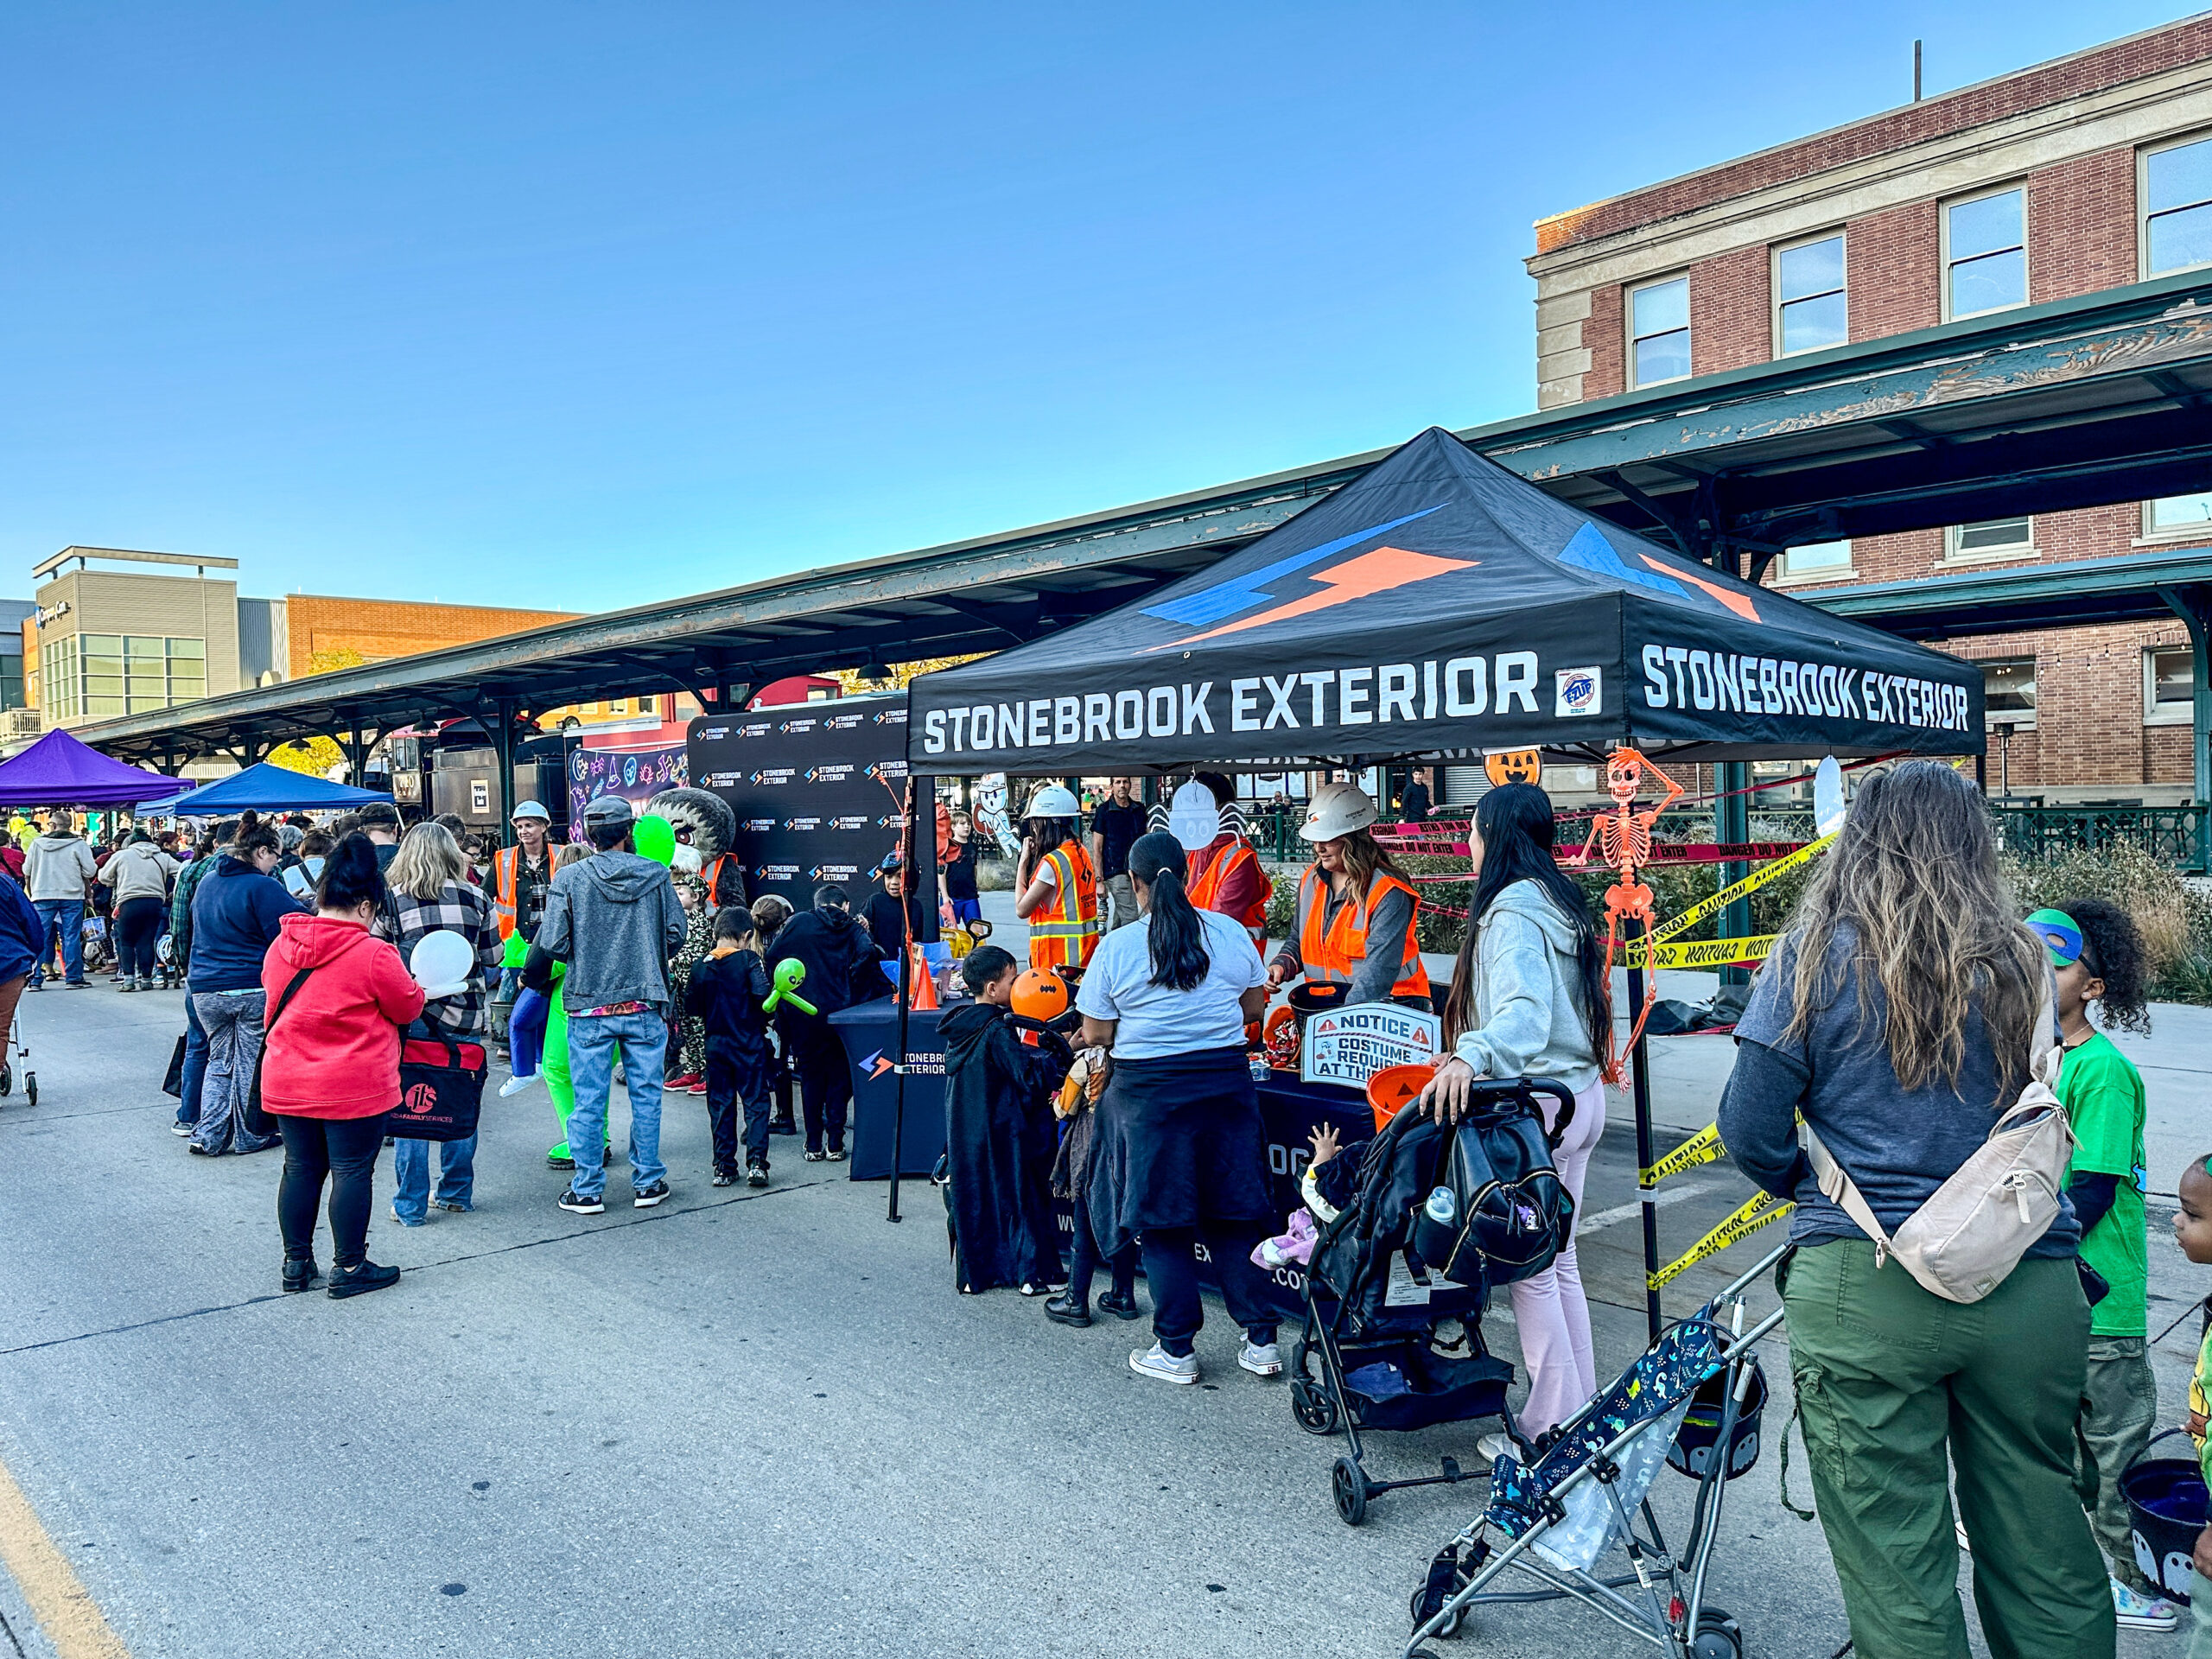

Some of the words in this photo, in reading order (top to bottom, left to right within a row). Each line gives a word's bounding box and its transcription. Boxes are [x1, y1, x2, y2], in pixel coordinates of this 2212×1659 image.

[1642, 644, 1859, 719] STONEBROOK
[1861, 671, 1968, 732] EXTERIOR
[924, 681, 1216, 754] STONEBROOK
[1230, 651, 1539, 732] EXTERIOR
[835, 714, 863, 722] STONEBROOK
[818, 764, 854, 774] STONEBROOK
[880, 760, 907, 769] STONEBR
[711, 772, 741, 780] STONEBROOK
[763, 768, 795, 778] STONEBROOK
[819, 773, 845, 782] EXTERIOR
[763, 777, 787, 785] EXTERIOR
[1417, 842, 1431, 853] NOT
[1432, 843, 1454, 854] ENTER
[1662, 845, 1688, 856] ENTER
[1719, 844, 1754, 856] DANGER
[823, 873, 849, 881] EXTERIOR
[1340, 1015, 1410, 1038] NOTICE
[1338, 1038, 1411, 1063] COSTUME
[1337, 1050, 1403, 1070] REQUIR
[910, 1064, 945, 1074] TERIOR
[1319, 1063, 1342, 1075] AT
